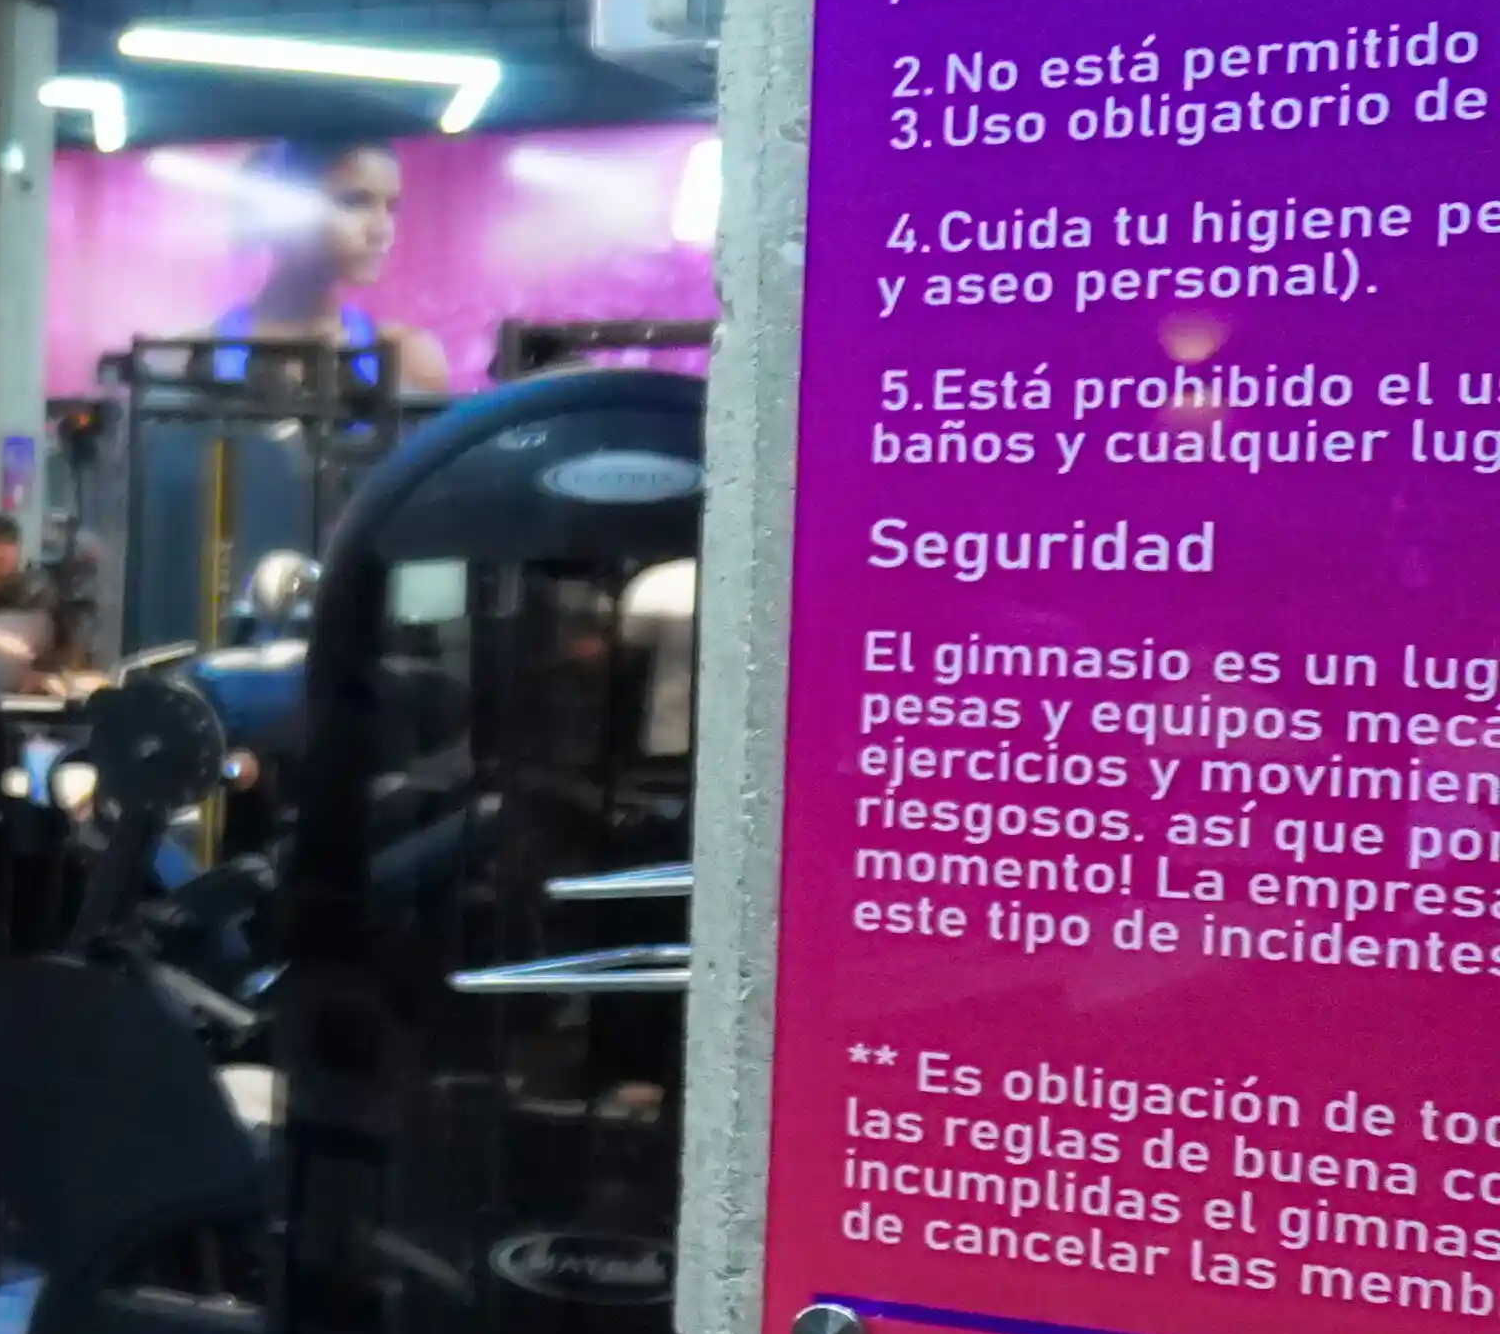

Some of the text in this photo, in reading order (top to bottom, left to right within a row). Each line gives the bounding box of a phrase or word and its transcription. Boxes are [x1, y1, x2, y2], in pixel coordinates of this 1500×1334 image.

[1041, 34, 1159, 88] está
[1184, 22, 1478, 91] permitido
[1068, 83, 1389, 146] obligatorio
[1416, 77, 1487, 122] de
[1114, 207, 1167, 246] tu
[1193, 198, 1411, 253] higiene
[878, 248, 1377, 317] y aseo personal).
[1074, 364, 1352, 420] prohibido
[1378, 362, 1433, 405] el
[872, 419, 1500, 474] baños y cualquier lug
[868, 518, 1214, 582] Seguridad
[865, 631, 1498, 702] El gimnasio es un lug
[861, 694, 1021, 733] pesas
[1042, 700, 1071, 742] y
[1091, 694, 1322, 748] equipos
[859, 736, 1127, 788] ejercicios
[1149, 759, 1180, 800] y
[858, 788, 1143, 844] riesgosos.
[1166, 800, 1256, 848] así
[1275, 819, 1384, 863] que
[856, 849, 1132, 895] momento!
[1158, 856, 1224, 901] La
[853, 897, 967, 937] este
[987, 901, 1090, 953] tipo
[1113, 909, 1179, 952] de
[918, 1051, 981, 1096] Es
[1003, 1062, 1299, 1127] obligación
[1325, 1091, 1395, 1136] de
[847, 1097, 923, 1142] las
[945, 1116, 1120, 1165] reglas
[1143, 1128, 1209, 1172] de
[1234, 1136, 1417, 1195] buena
[845, 1148, 1181, 1223] incumplidas
[1204, 1191, 1256, 1233] el
[842, 1201, 903, 1244] de
[925, 1220, 1170, 1275] cancelar
[1192, 1240, 1276, 1289] las
